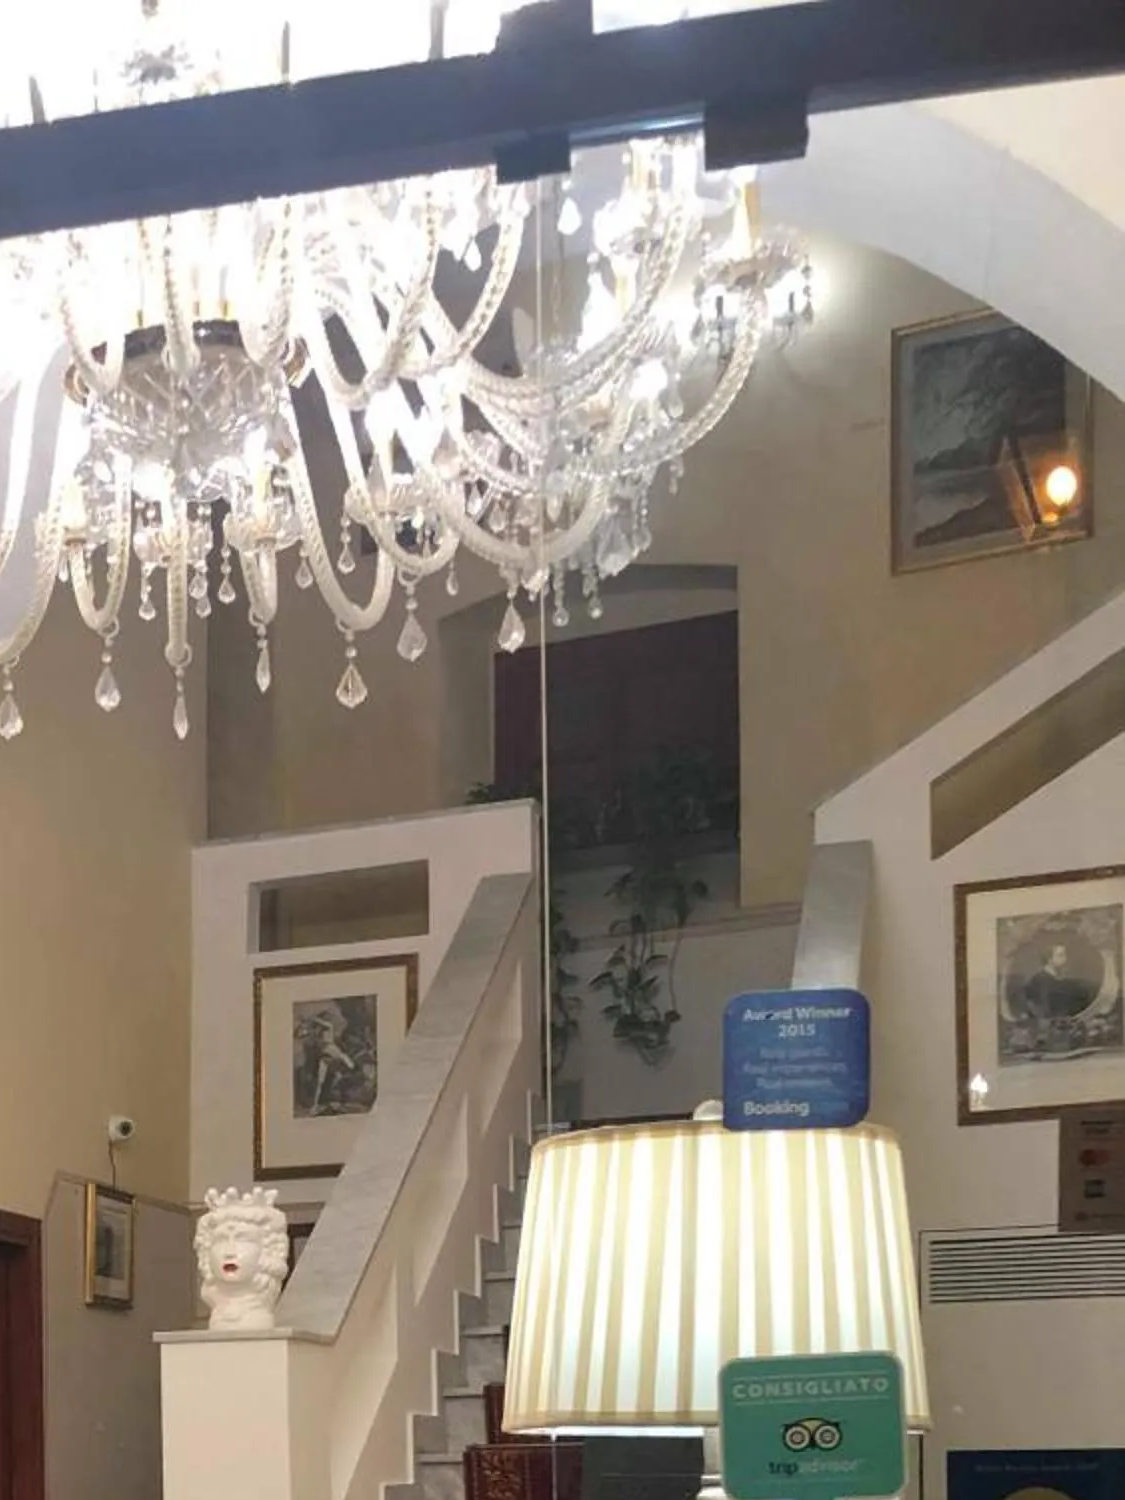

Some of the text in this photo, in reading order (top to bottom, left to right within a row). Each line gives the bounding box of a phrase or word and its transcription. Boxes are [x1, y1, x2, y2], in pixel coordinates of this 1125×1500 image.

[796, 1006, 851, 1020] Winner
[778, 1023, 816, 1037] 2015
[732, 1377, 889, 1399] CONSIGLIATO
